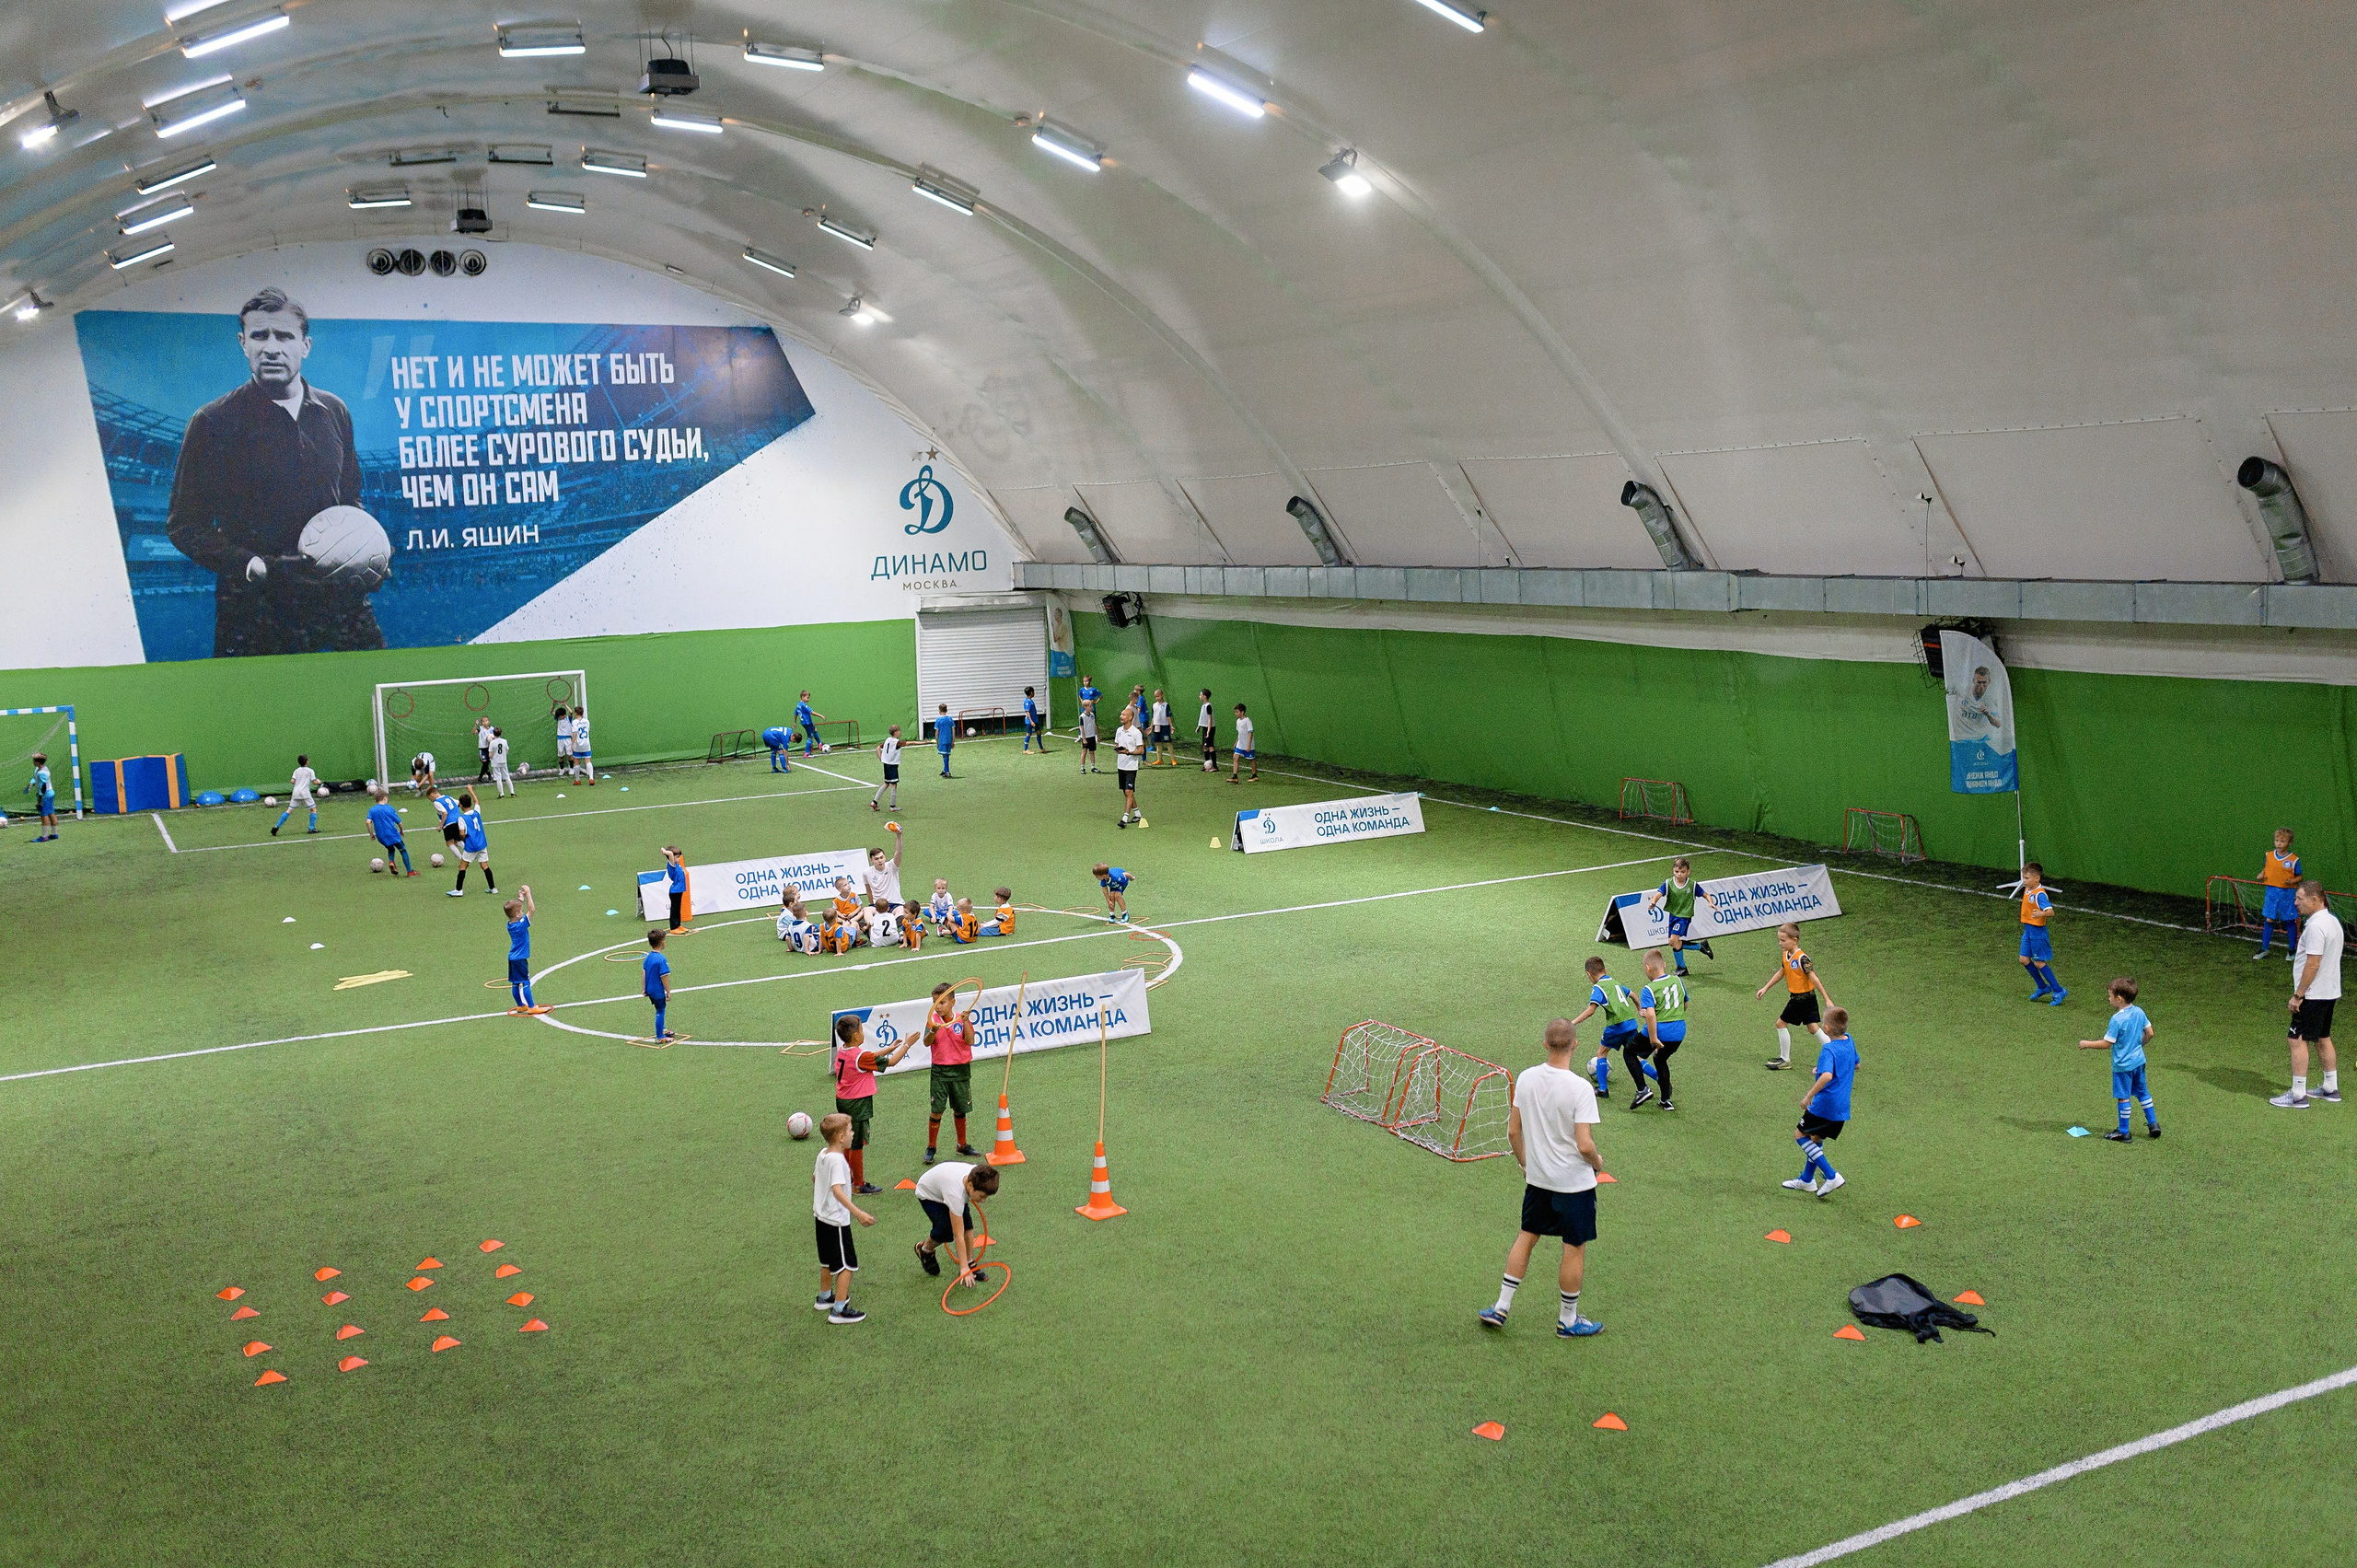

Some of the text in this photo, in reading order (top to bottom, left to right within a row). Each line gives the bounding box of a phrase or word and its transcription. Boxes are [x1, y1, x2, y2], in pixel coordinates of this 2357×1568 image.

[391, 353, 675, 389] НЕТ И НЕ МОЖЕТ БЫТЬ
[394, 391, 588, 429] У СПОРТСМЕНА
[399, 427, 709, 469] БОЛЕЕ СУРОВОГО СУДЬИ,
[401, 470, 560, 508] ЧЕМ ОН САМ
[406, 525, 540, 551] Л.И. ЯШИН
[870, 550, 988, 581] ДИНАМО
[902, 579, 958, 591] МОСКВА
[578, 726, 587, 738] 25
[497, 743, 503, 754] 8
[1314, 809, 1348, 824] ОДНА
[1349, 805, 1389, 819] ЖИЗНЬ
[1317, 816, 1411, 838] ОДНА КОМАНДА
[1260, 837, 1284, 845] ШКОЛА
[735, 869, 778, 886] ОДНА
[780, 863, 830, 879] ЖИЗНЬ
[737, 874, 855, 900] ОДНА ОМАНА
[1710, 889, 1748, 908] ОДНА
[1747, 881, 1796, 900] ЖИЗНЬ
[1713, 894, 1823, 925] ОДНА КОМАНДА
[793, 932, 803, 948] 9
[882, 920, 890, 937] 2
[968, 921, 979, 938] 12
[1647, 926, 1668, 936] ШКО
[1614, 984, 1630, 1007] 4
[1662, 983, 1680, 1010] 11
[968, 1003, 1023, 1027] ОДНА
[1026, 992, 1095, 1017] ЖИЗНЬ
[971, 1008, 1128, 1049] ОДНА КОМАНДА
[838, 1058, 846, 1085] 7
